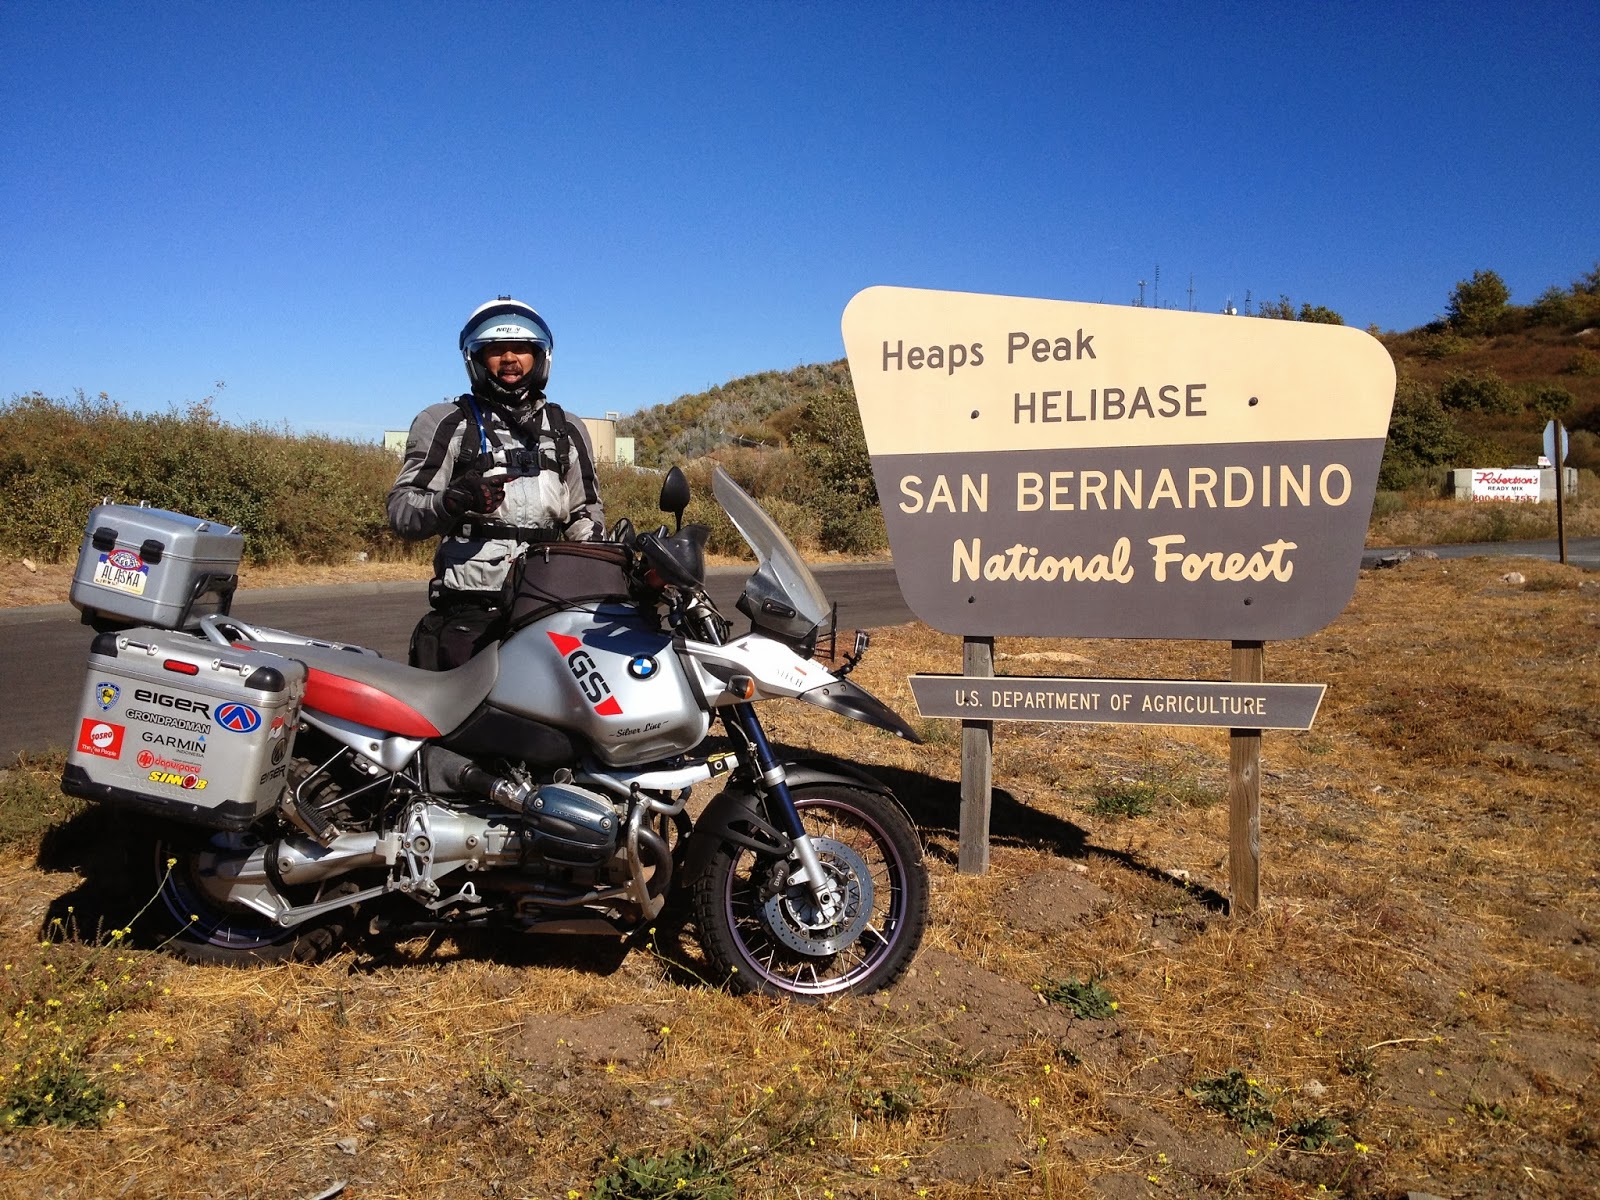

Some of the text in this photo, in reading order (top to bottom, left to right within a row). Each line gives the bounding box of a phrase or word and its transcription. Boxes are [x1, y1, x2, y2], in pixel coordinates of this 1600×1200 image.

[882, 328, 1097, 376] Heaps Peak
[1014, 383, 1207, 424] HELIBASE
[899, 463, 1352, 513] SAN BERNARDINO
[1474, 472, 1538, 484] Robertson's
[951, 534, 1299, 584] National Forest
[101, 565, 140, 587] ALASKA
[568, 650, 611, 703] GS
[955, 689, 1267, 715] U.S. DEPARTMENT OF AGRICULTURE
[126, 709, 211, 734] GRONDPADMAN
[616, 722, 662, 738] Silver Line
[92, 731, 113, 741] SOSRO
[142, 731, 207, 754] GARMIN
[774, 869, 784, 887] BMW
